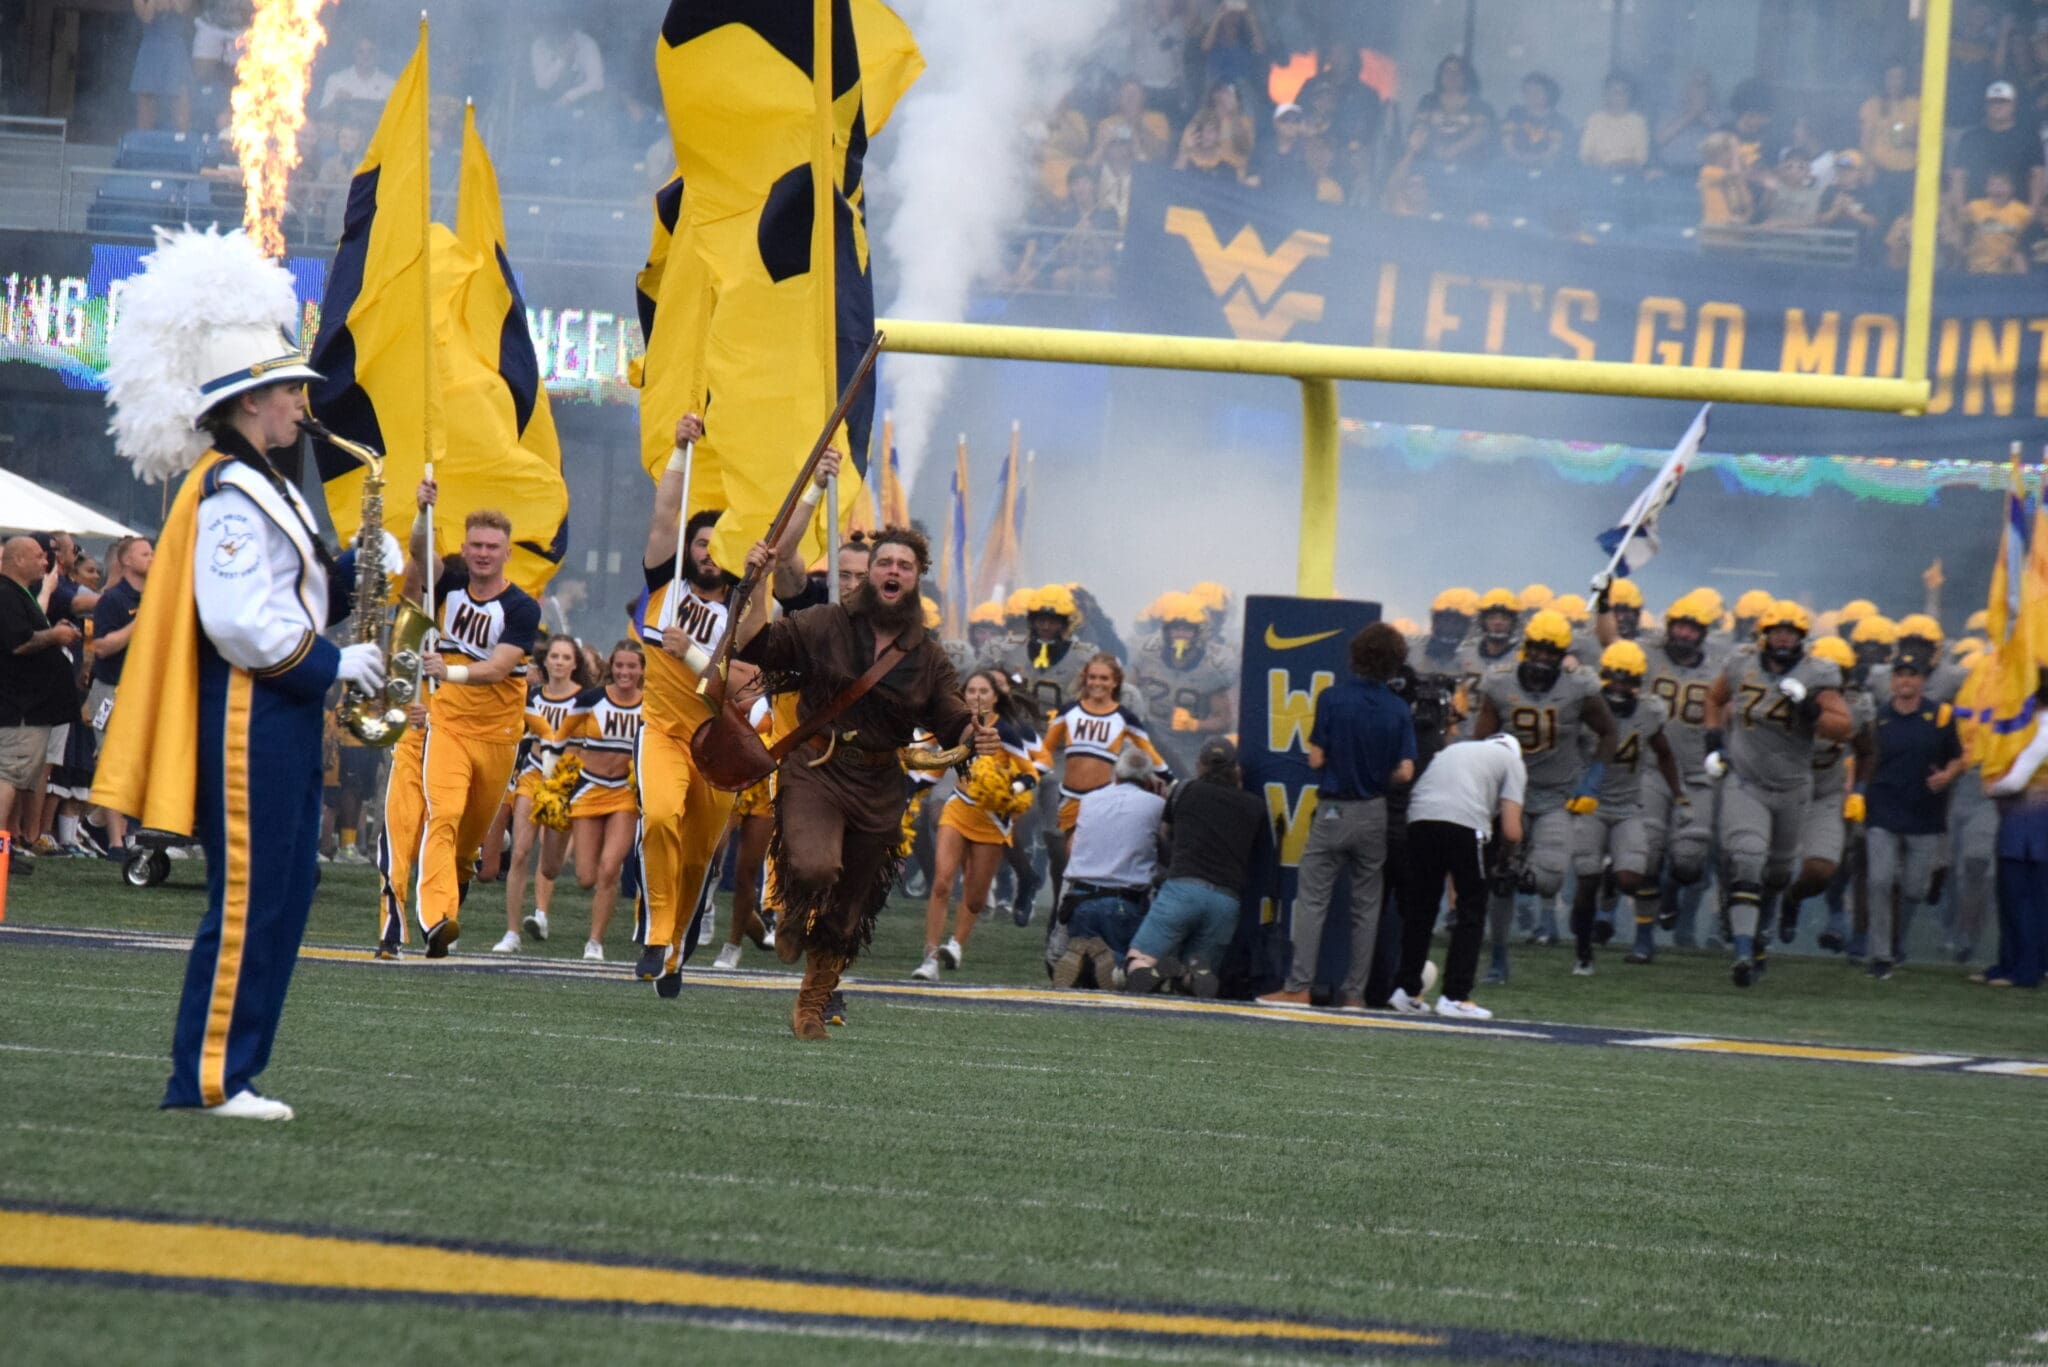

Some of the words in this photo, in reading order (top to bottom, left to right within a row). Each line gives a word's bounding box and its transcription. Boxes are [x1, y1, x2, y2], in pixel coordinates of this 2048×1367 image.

[1373, 262, 1600, 362] LET'S
[1632, 296, 1746, 370] GO
[451, 601, 492, 649] WVU
[675, 593, 719, 646] WVU
[1073, 718, 1112, 743] WVU
[1511, 706, 1557, 754] 91
[1738, 683, 1794, 731] 74
